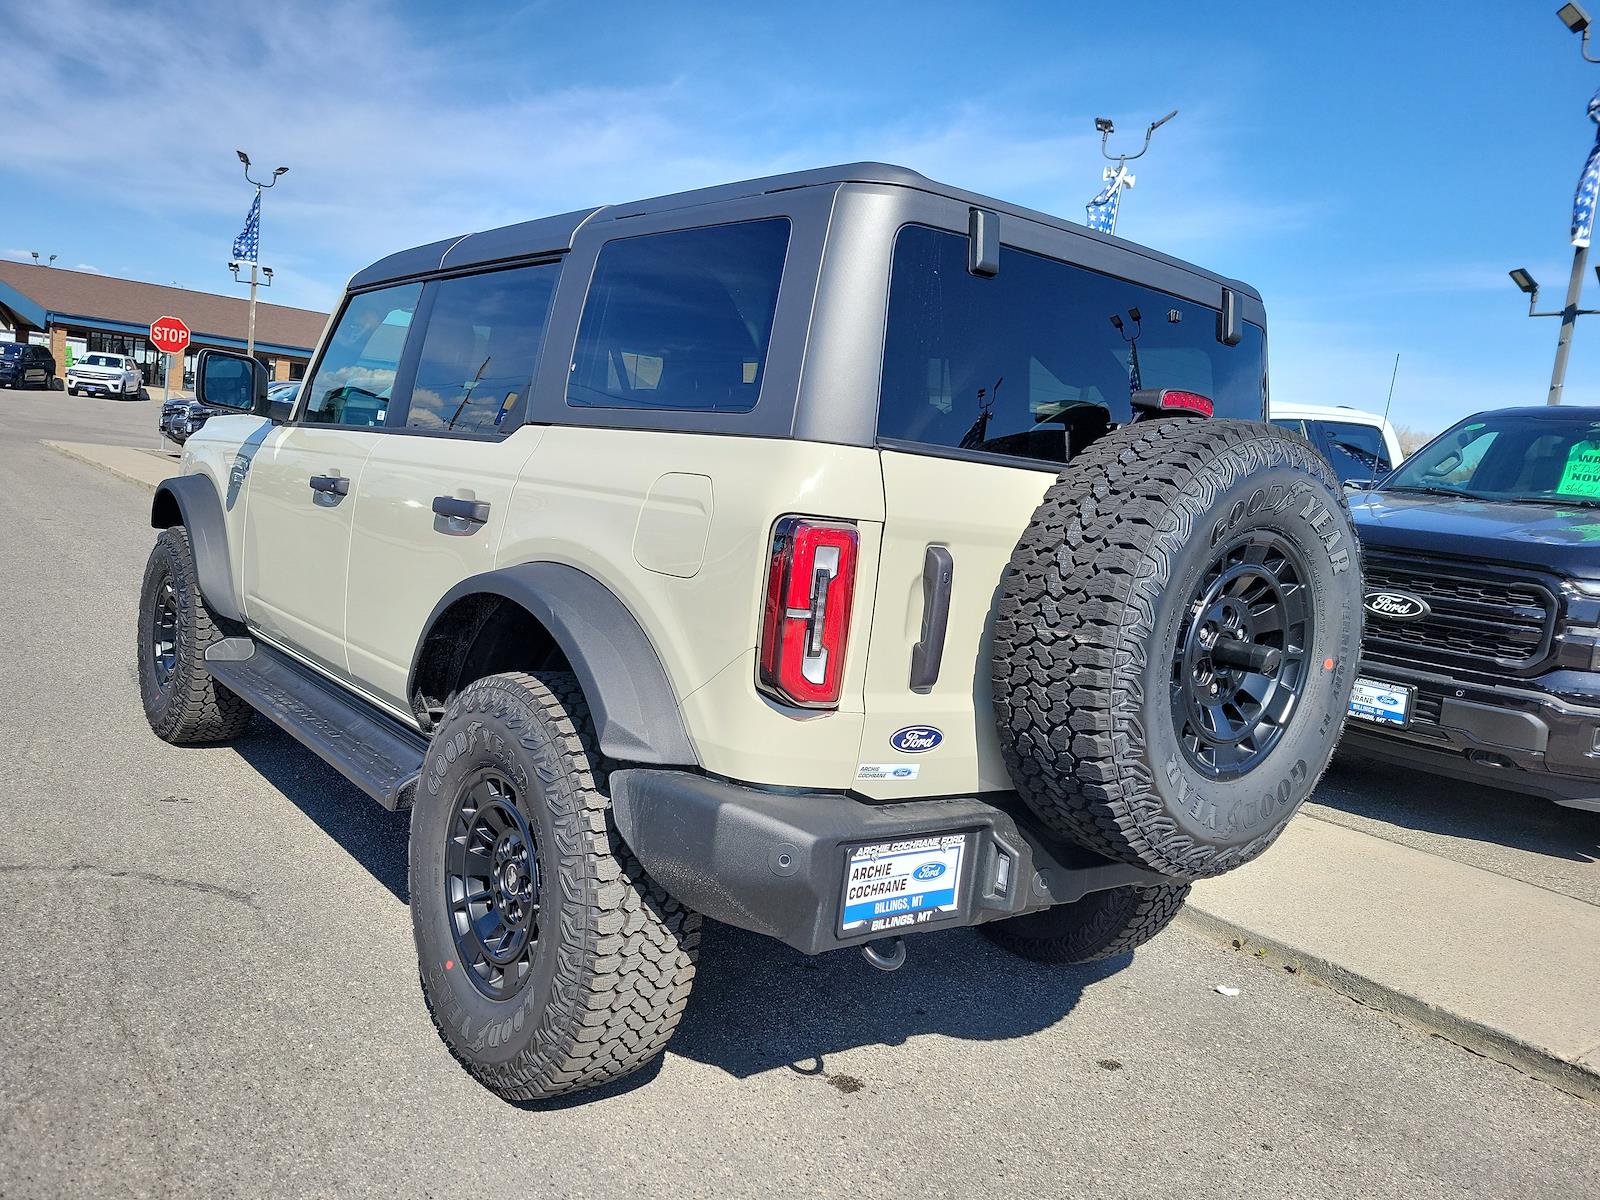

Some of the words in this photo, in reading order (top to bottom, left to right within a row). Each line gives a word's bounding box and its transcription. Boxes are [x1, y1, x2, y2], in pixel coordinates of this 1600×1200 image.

[153, 326, 187, 344] STOP
[1579, 454, 1600, 464] WA
[1210, 479, 1350, 576] GOODYEAR
[1372, 595, 1412, 614] Ford
[901, 730, 936, 748] Ford
[428, 721, 528, 796] GOODYEAR
[856, 844, 890, 856] ARCHIE
[891, 837, 940, 852] COCHRANE
[940, 835, 965, 846] FORD
[852, 863, 892, 881] ARCHIE
[919, 863, 941, 878] Ford
[849, 878, 907, 900] COCHRANE
[874, 898, 910, 914] BILLINGS,
[912, 895, 924, 907] MT
[871, 913, 915, 931] BILLINGS,
[917, 911, 933, 922] MT
